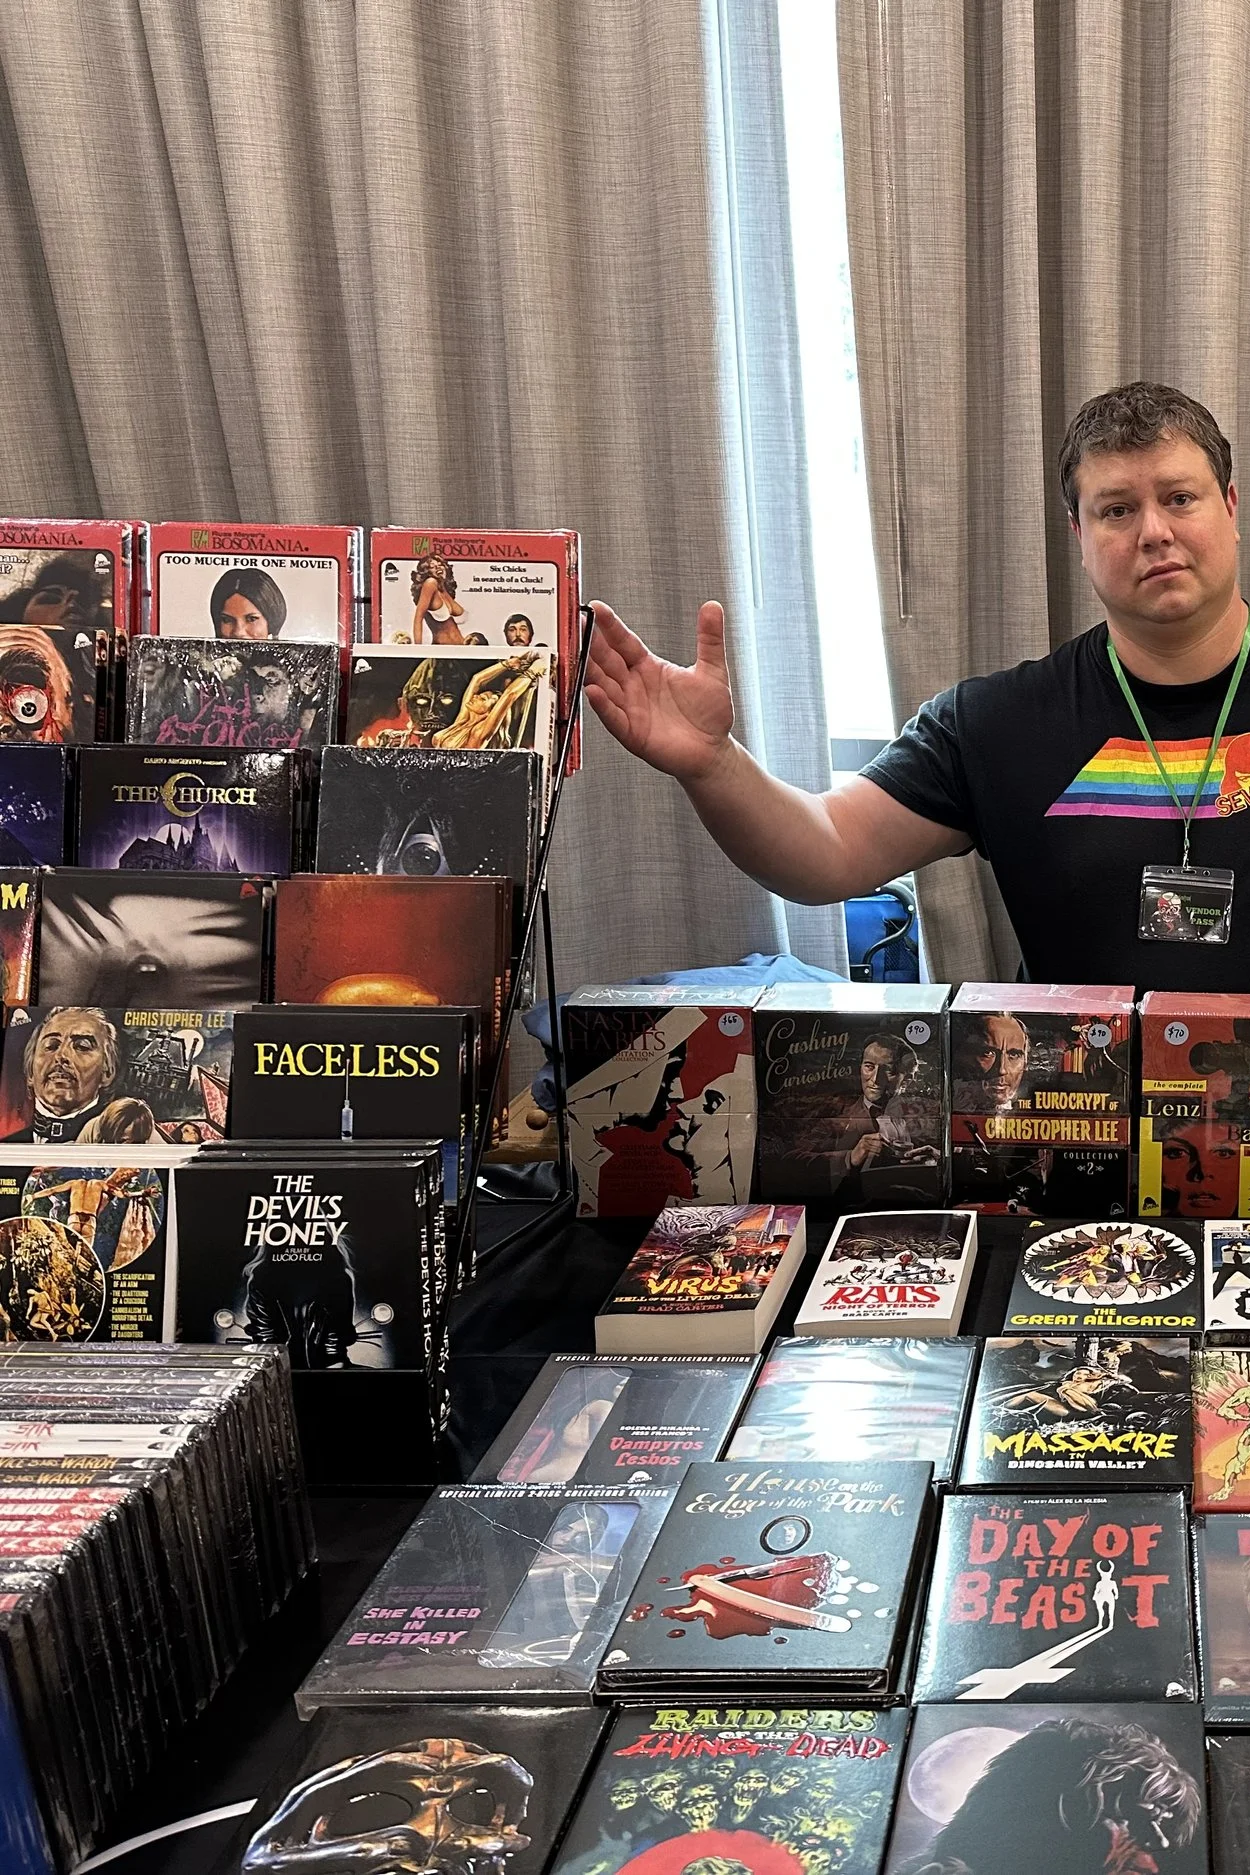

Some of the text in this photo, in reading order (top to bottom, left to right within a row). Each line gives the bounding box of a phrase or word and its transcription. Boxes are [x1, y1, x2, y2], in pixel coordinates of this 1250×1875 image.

[165, 555, 333, 569] TOO MUCH FOR ONE MOVIE!
[489, 565, 527, 573] Six Chicks
[112, 771, 257, 818] THE CHURCH
[1185, 906, 1222, 917] VENDOR
[1190, 917, 1215, 927] PASS
[124, 1010, 226, 1029] CHRISTOPHER LEE
[764, 1018, 851, 1062] Cushing
[1168, 1028, 1185, 1039] $70
[254, 1042, 440, 1078] FACELESS
[764, 1056, 854, 1095] Curiosities
[1153, 1081, 1205, 1091] the complete
[1018, 1091, 1119, 1111] THE EUROCRYPT OF
[985, 1116, 1119, 1142] CHRISTOPHER LEE
[1063, 1151, 1120, 1161] COLLECTION
[273, 1175, 314, 1194] THE
[247, 1195, 344, 1219] DEVIL'S
[244, 1221, 349, 1246] HONEY
[272, 1253, 323, 1262] LUCIO FULCI
[646, 1274, 743, 1296] VIRUS
[820, 1285, 941, 1306] RATS
[867, 1303, 879, 1311] OF
[881, 1302, 936, 1311] TERROR
[1093, 1307, 1117, 1316] THE
[1010, 1314, 1197, 1327] GREAT ALLIGATOR
[609, 1436, 705, 1452] Vampyros
[984, 1429, 1179, 1460] MASSACRE
[61, 1457, 119, 1469] WARDH
[614, 1452, 682, 1467] Lesbos
[1007, 1460, 1147, 1470] DINOSAUR VALLEY
[36, 1472, 96, 1484] WARDH
[725, 1468, 838, 1494] House
[439, 1489, 670, 1499] SPECIAL LIMITED 2-DISC COLLECTORS EDITION
[685, 1492, 766, 1518] Edge
[816, 1491, 905, 1517] Park
[987, 1506, 1025, 1520] THE
[968, 1508, 1163, 1566] DAY OF
[1023, 1559, 1093, 1578] THE
[949, 1570, 1170, 1630] BEAST
[363, 1605, 482, 1619] SHE KILLED
[402, 1620, 426, 1631] IN
[346, 1631, 468, 1646] ECSTASY
[650, 1708, 880, 1732] RAIDERS
[612, 1732, 894, 1760] LIVING DEAD
